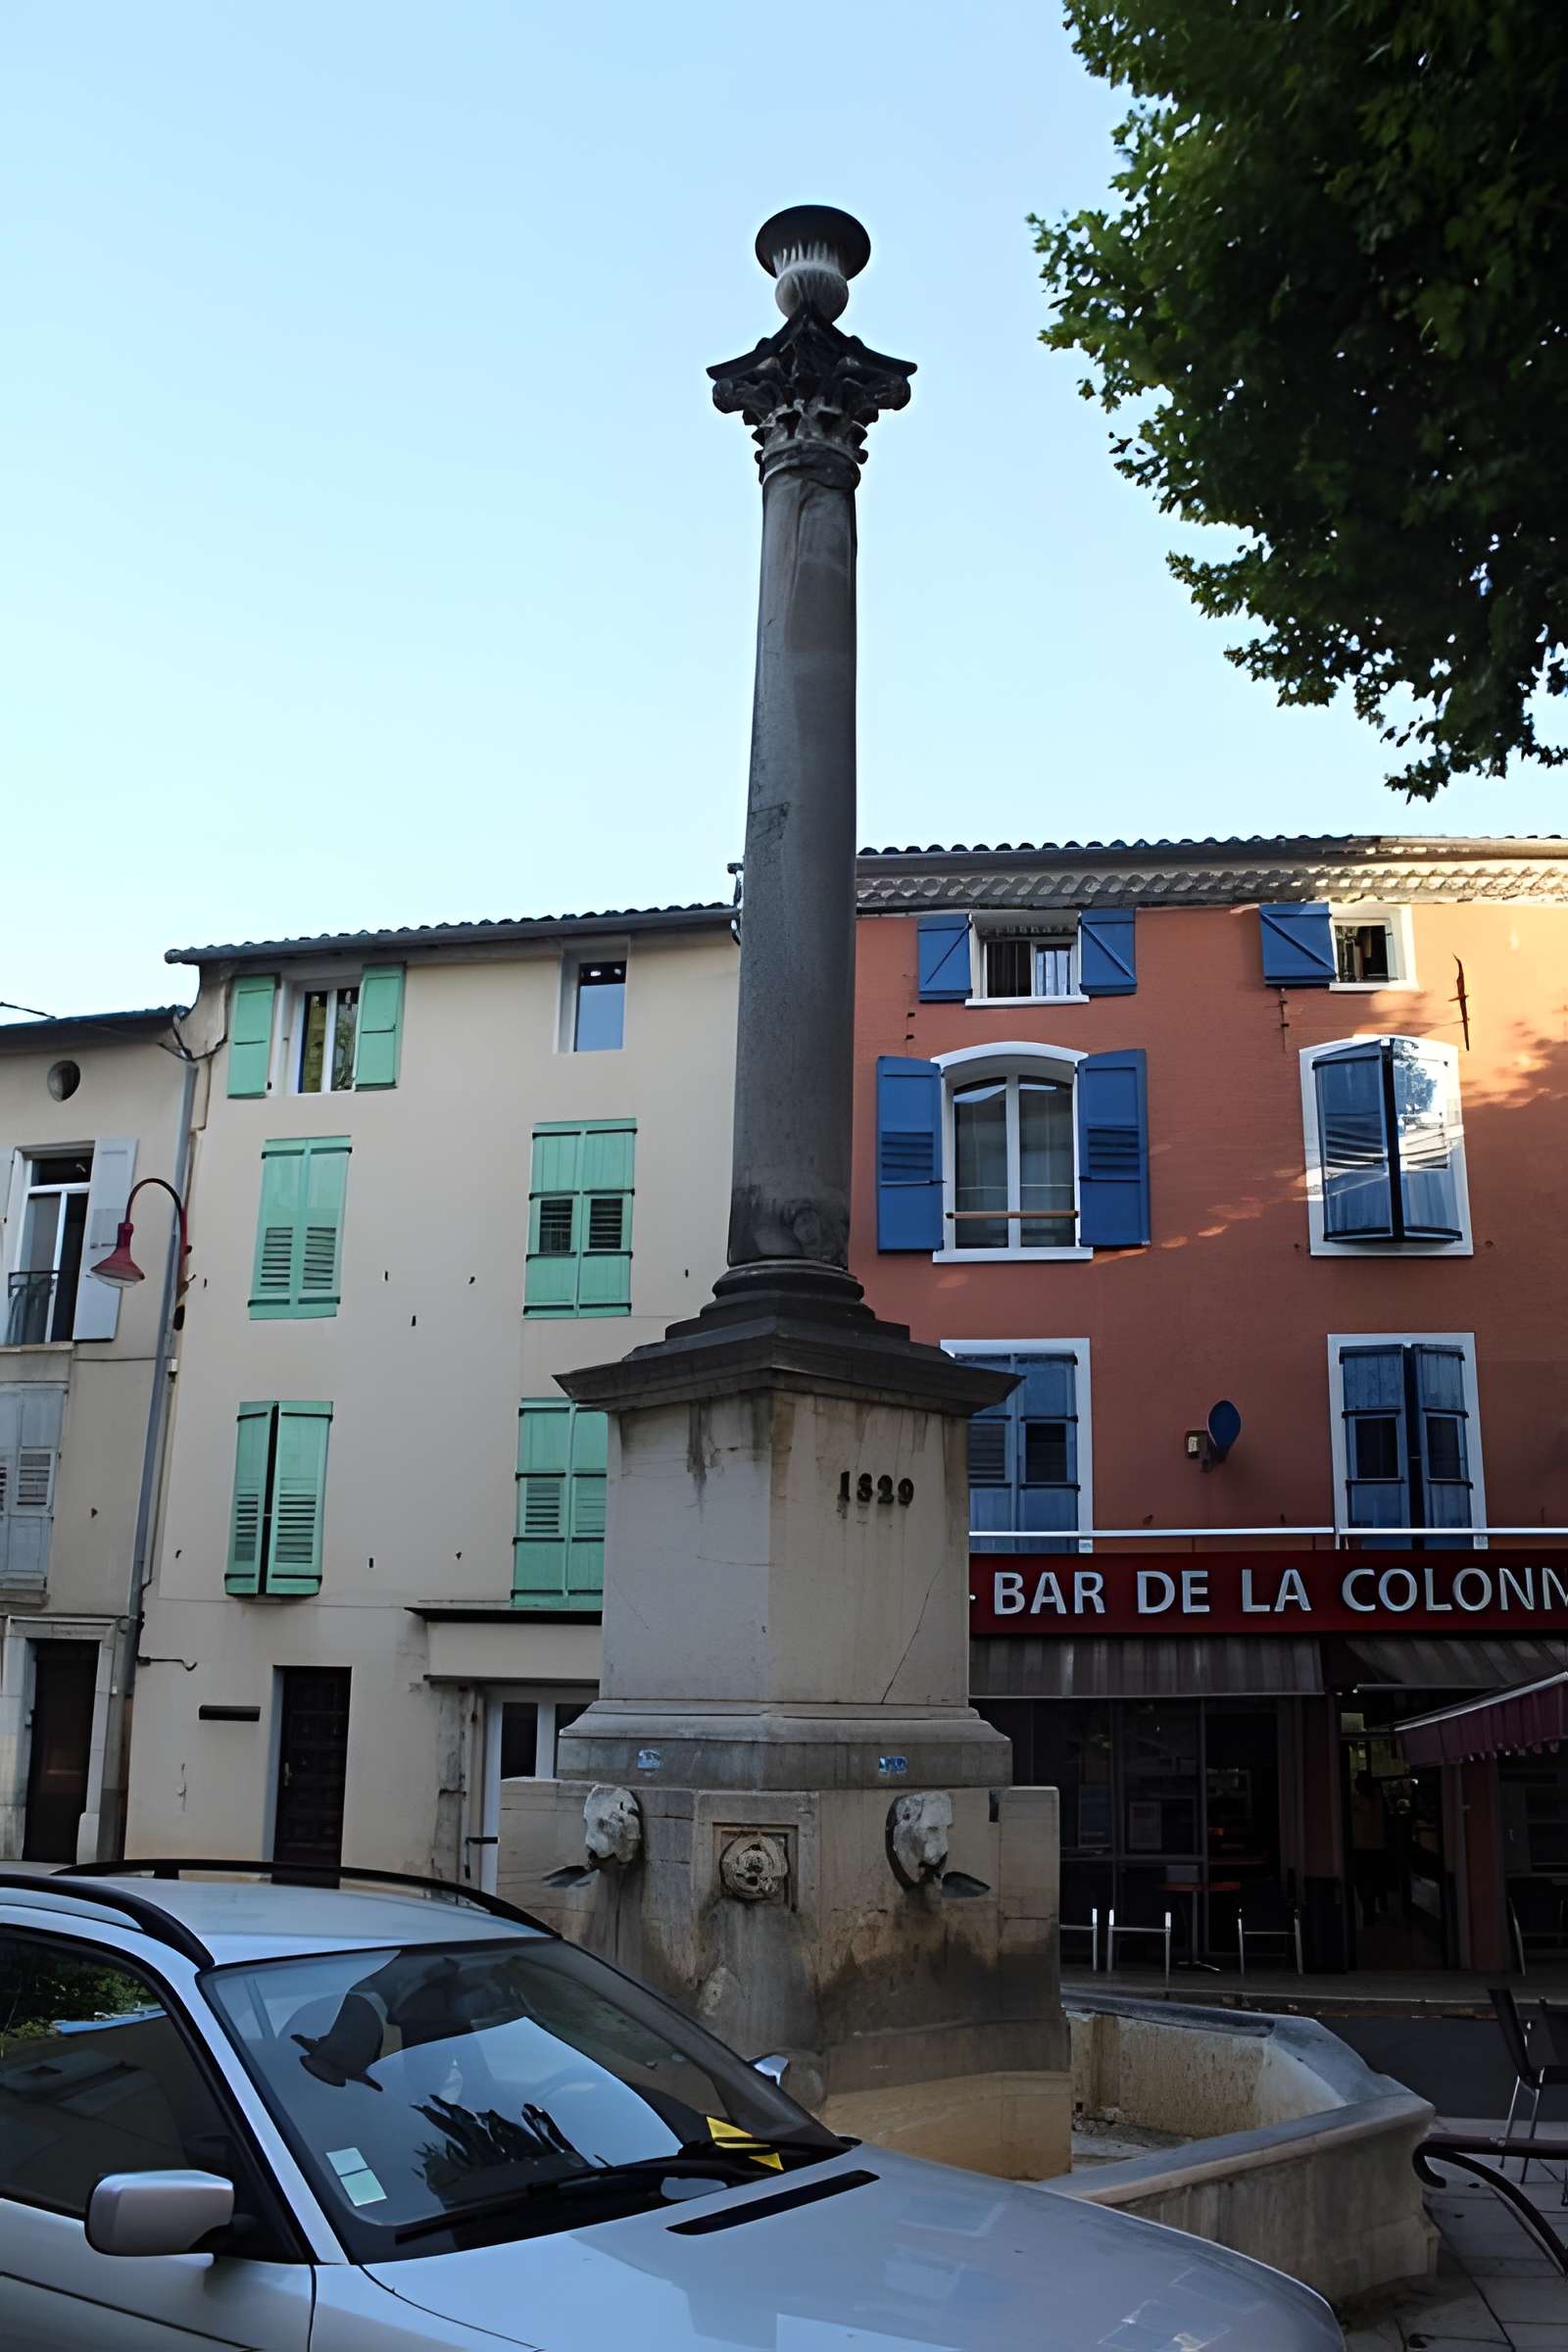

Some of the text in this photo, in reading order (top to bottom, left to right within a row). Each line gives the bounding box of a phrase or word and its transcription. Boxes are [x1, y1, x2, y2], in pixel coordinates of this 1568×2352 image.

[993, 1571, 1106, 1615] BAR
[1136, 1570, 1211, 1614] DE
[1241, 1568, 1313, 1613] LA
